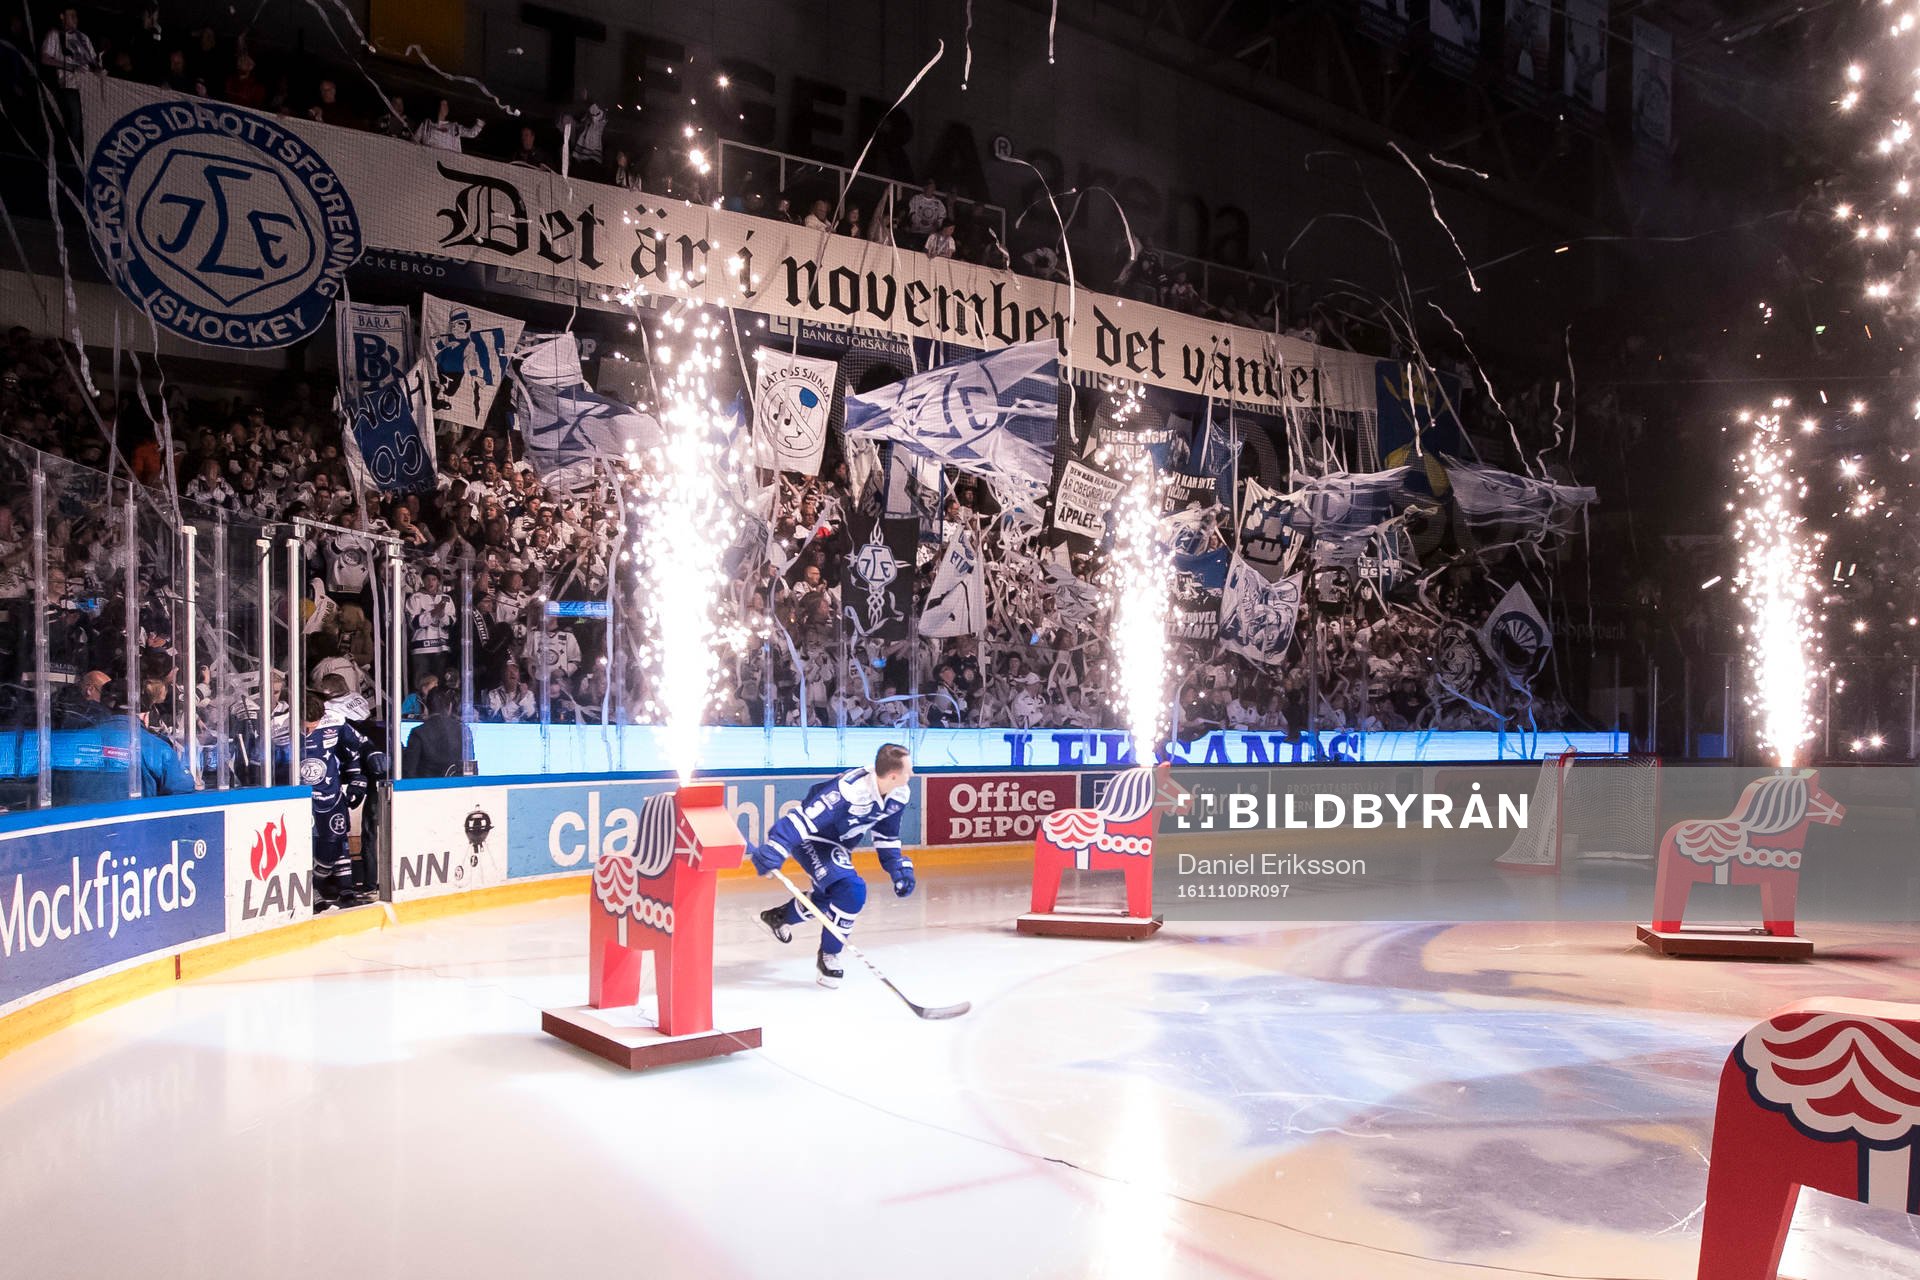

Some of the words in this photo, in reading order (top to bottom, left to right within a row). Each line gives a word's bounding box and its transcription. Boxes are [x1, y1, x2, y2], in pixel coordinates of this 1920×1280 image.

[437, 160, 605, 271] Det
[631, 204, 711, 289] är
[781, 255, 1077, 358] november
[1093, 304, 1167, 380] det
[145, 286, 307, 346] ISHOCKEY
[358, 315, 392, 329] BARA
[801, 328, 834, 344] BANK
[949, 782, 1056, 813] Office
[548, 791, 640, 868] cla
[393, 850, 450, 891] NN
